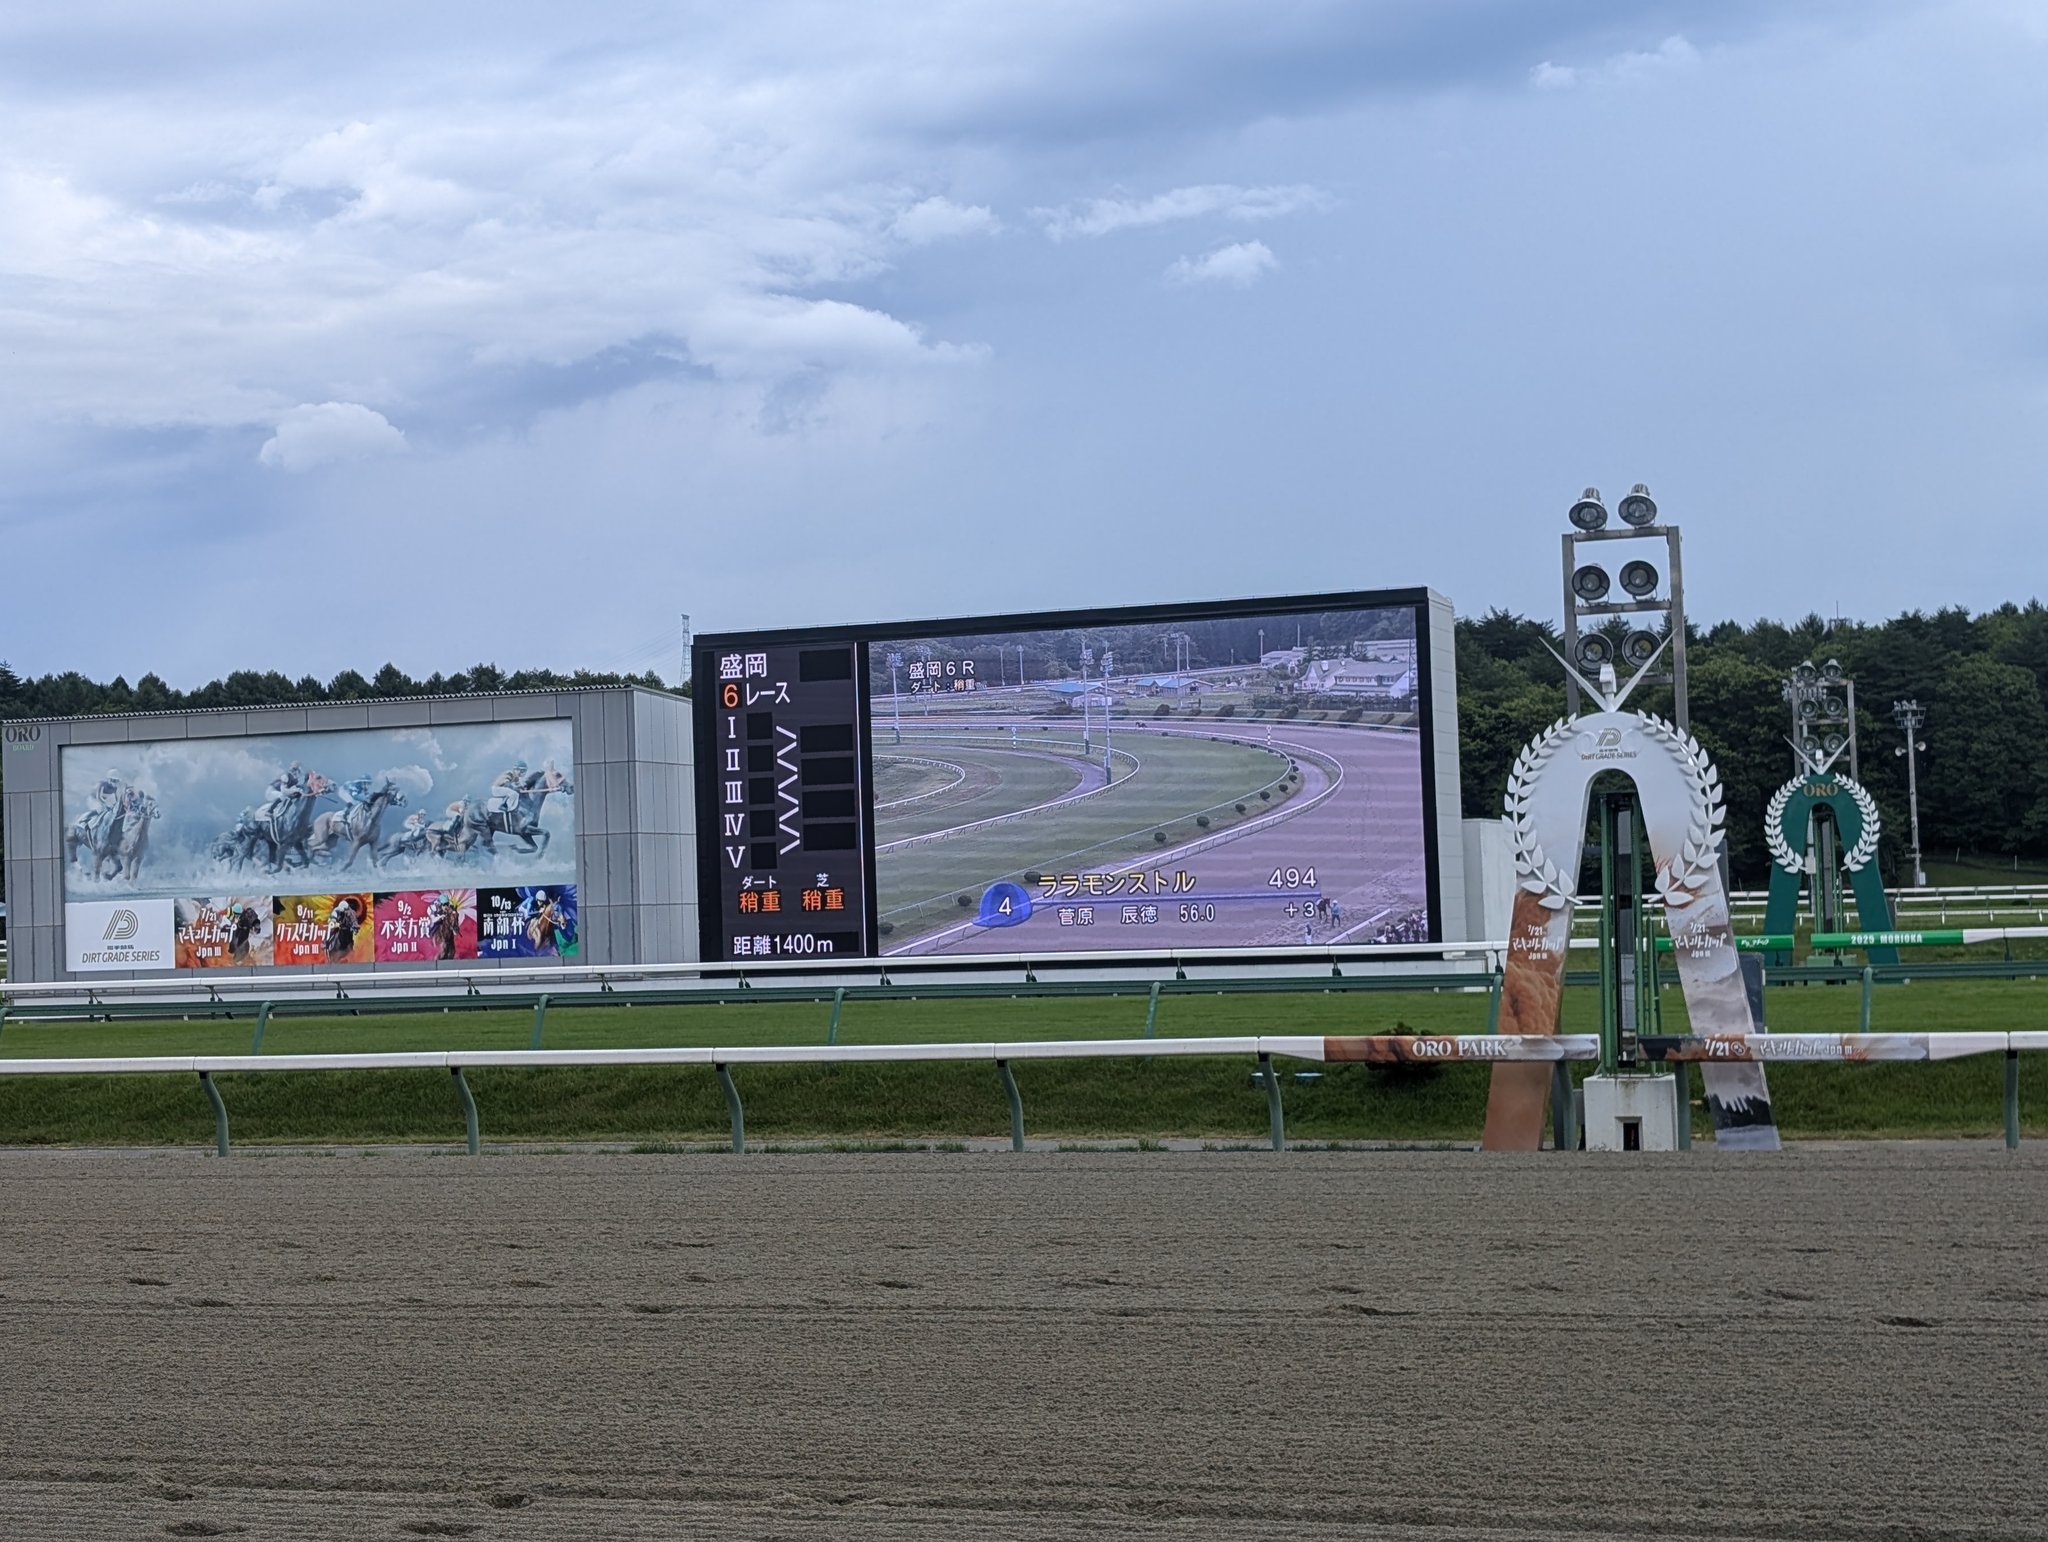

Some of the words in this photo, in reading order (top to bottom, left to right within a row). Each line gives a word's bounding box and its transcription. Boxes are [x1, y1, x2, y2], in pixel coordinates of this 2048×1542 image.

[720, 653, 767, 679] 盛岡
[5, 726, 41, 742] ORO
[1803, 783, 1839, 797] ORO
[726, 846, 746, 868] V
[742, 875, 777, 890] ダート
[816, 872, 829, 887] 芝
[1037, 871, 1196, 898] ララモンストル
[1268, 866, 1317, 889] 494
[490, 895, 511, 911] 10/13
[739, 890, 781, 913] 稍重
[802, 888, 844, 911] 稍重
[998, 897, 1012, 915] 4
[201, 908, 217, 922] 7/21
[297, 905, 314, 919] 8/11
[398, 900, 412, 916] 9/2
[1058, 907, 1094, 926] 菅原
[1121, 905, 1159, 924] 辰徳
[1179, 903, 1216, 923] 56.0
[1284, 902, 1316, 920] +3
[178, 924, 237, 944] マーキュリーカップ
[277, 920, 336, 942] クラスターカップ
[381, 917, 431, 940] 不来方賞
[483, 917, 525, 936] 南部杯
[1528, 924, 1543, 936] 7/21
[1690, 922, 1705, 933] 7/21
[491, 938, 508, 951] Jpn
[1851, 934, 1875, 944] 2025
[1880, 934, 1923, 944] MORIOKA
[196, 946, 212, 959] Jpn
[293, 944, 310, 955] Jpn
[391, 941, 408, 954] Jpn
[82, 952, 100, 963] DIRT
[102, 951, 130, 963] GRADE
[131, 950, 160, 962] SERIES
[1412, 1040, 1450, 1057] ORO
[1458, 1039, 1508, 1057] PARK
[1704, 1038, 1730, 1057] 7/21
